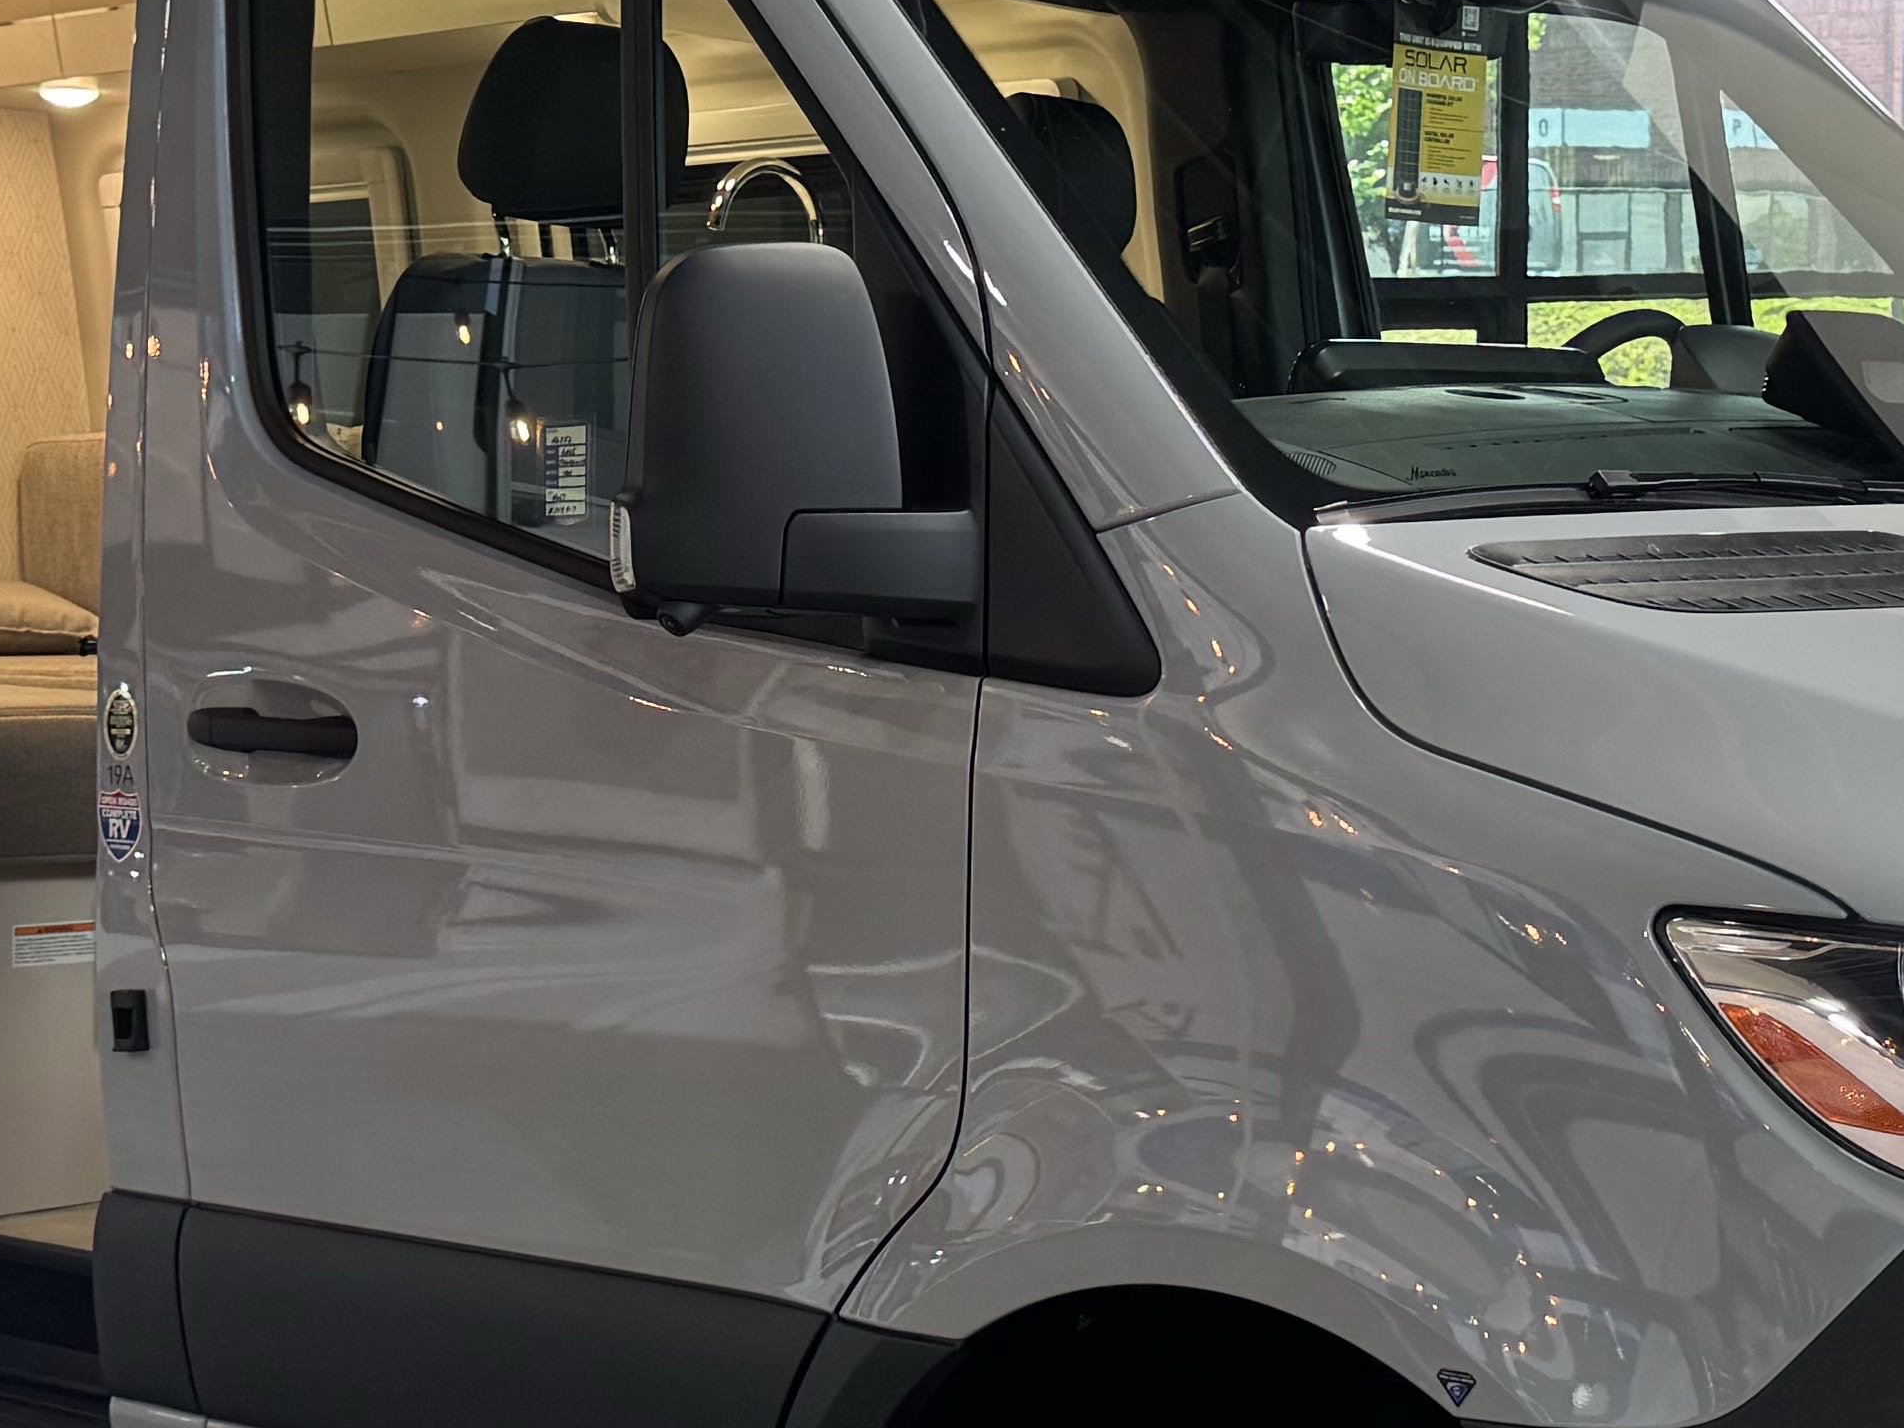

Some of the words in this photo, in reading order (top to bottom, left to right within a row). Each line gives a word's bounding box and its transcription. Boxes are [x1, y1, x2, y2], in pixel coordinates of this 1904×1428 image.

[1405, 50, 1467, 74] SOLAR
[1399, 67, 1415, 84] ON
[108, 765, 134, 785] 19A
[109, 818, 132, 839] RV
